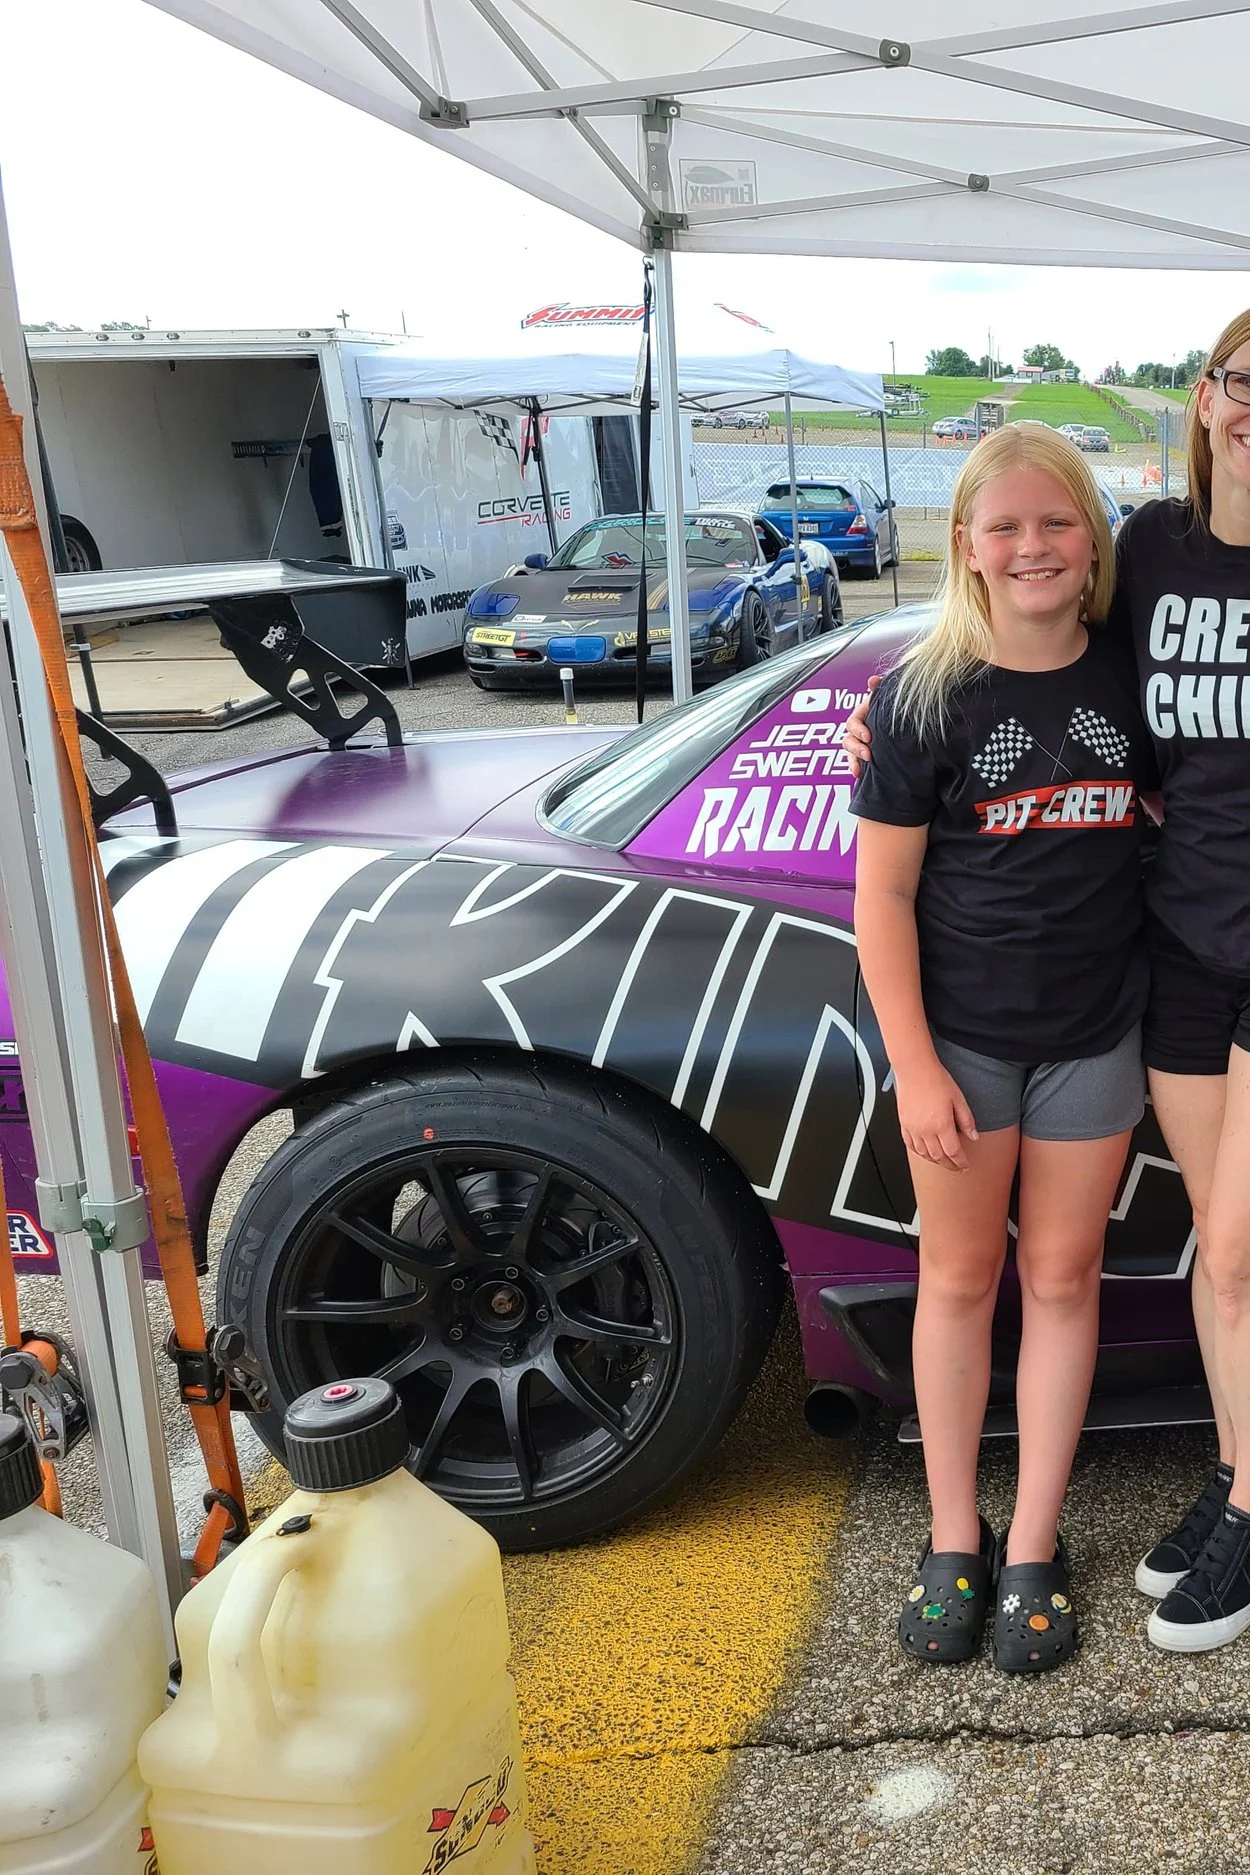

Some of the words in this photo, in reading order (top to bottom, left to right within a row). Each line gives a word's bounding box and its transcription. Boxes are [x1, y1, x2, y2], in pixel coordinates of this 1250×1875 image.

[834, 689, 870, 710] You
[984, 796, 1036, 831] PIT
[1041, 786, 1133, 823] CREW
